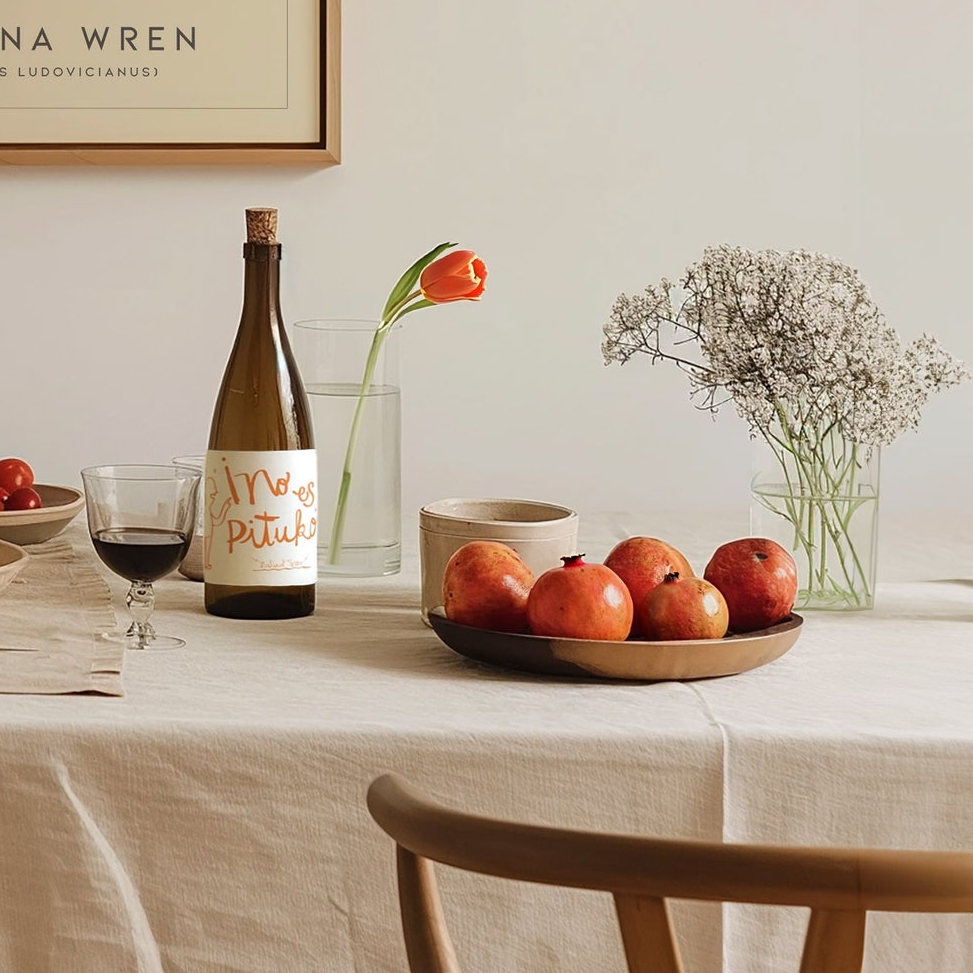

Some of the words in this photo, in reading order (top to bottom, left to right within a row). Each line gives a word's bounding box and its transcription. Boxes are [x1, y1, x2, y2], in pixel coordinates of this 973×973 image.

[80, 25, 196, 51] WREN
[17, 66, 159, 78] LUDOVICIANUS)
[292, 481, 315, 507] es
